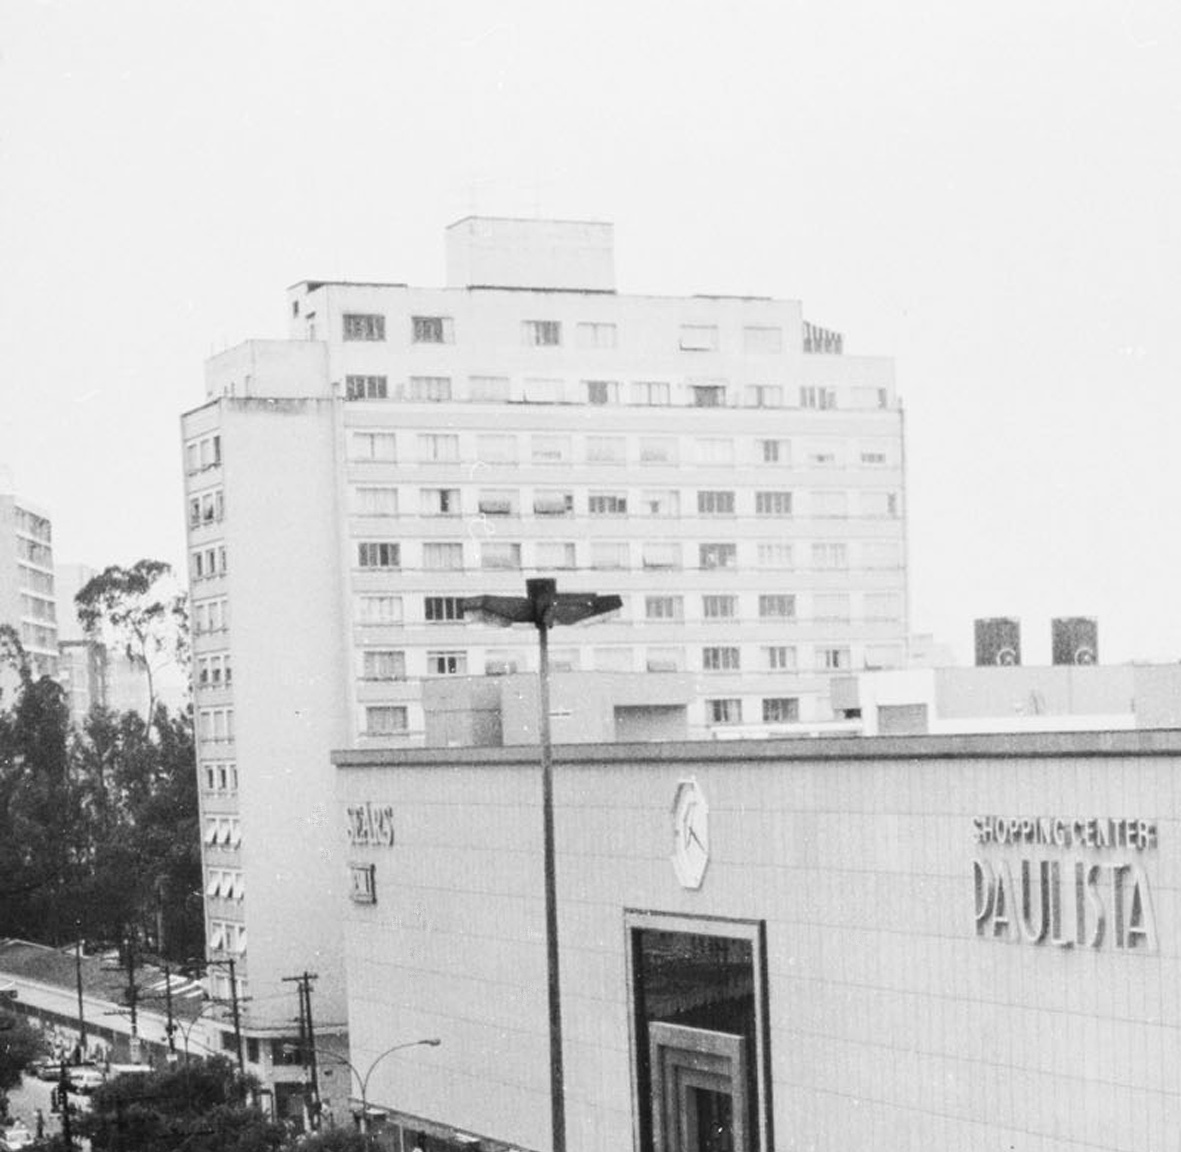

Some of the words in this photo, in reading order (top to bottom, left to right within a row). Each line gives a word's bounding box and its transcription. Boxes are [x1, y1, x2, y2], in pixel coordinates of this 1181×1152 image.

[347, 802, 395, 847] SEARS
[972, 815, 1066, 846] SHOPPING
[1069, 817, 1157, 850] CENTER
[972, 859, 1159, 952] PAULISTA
